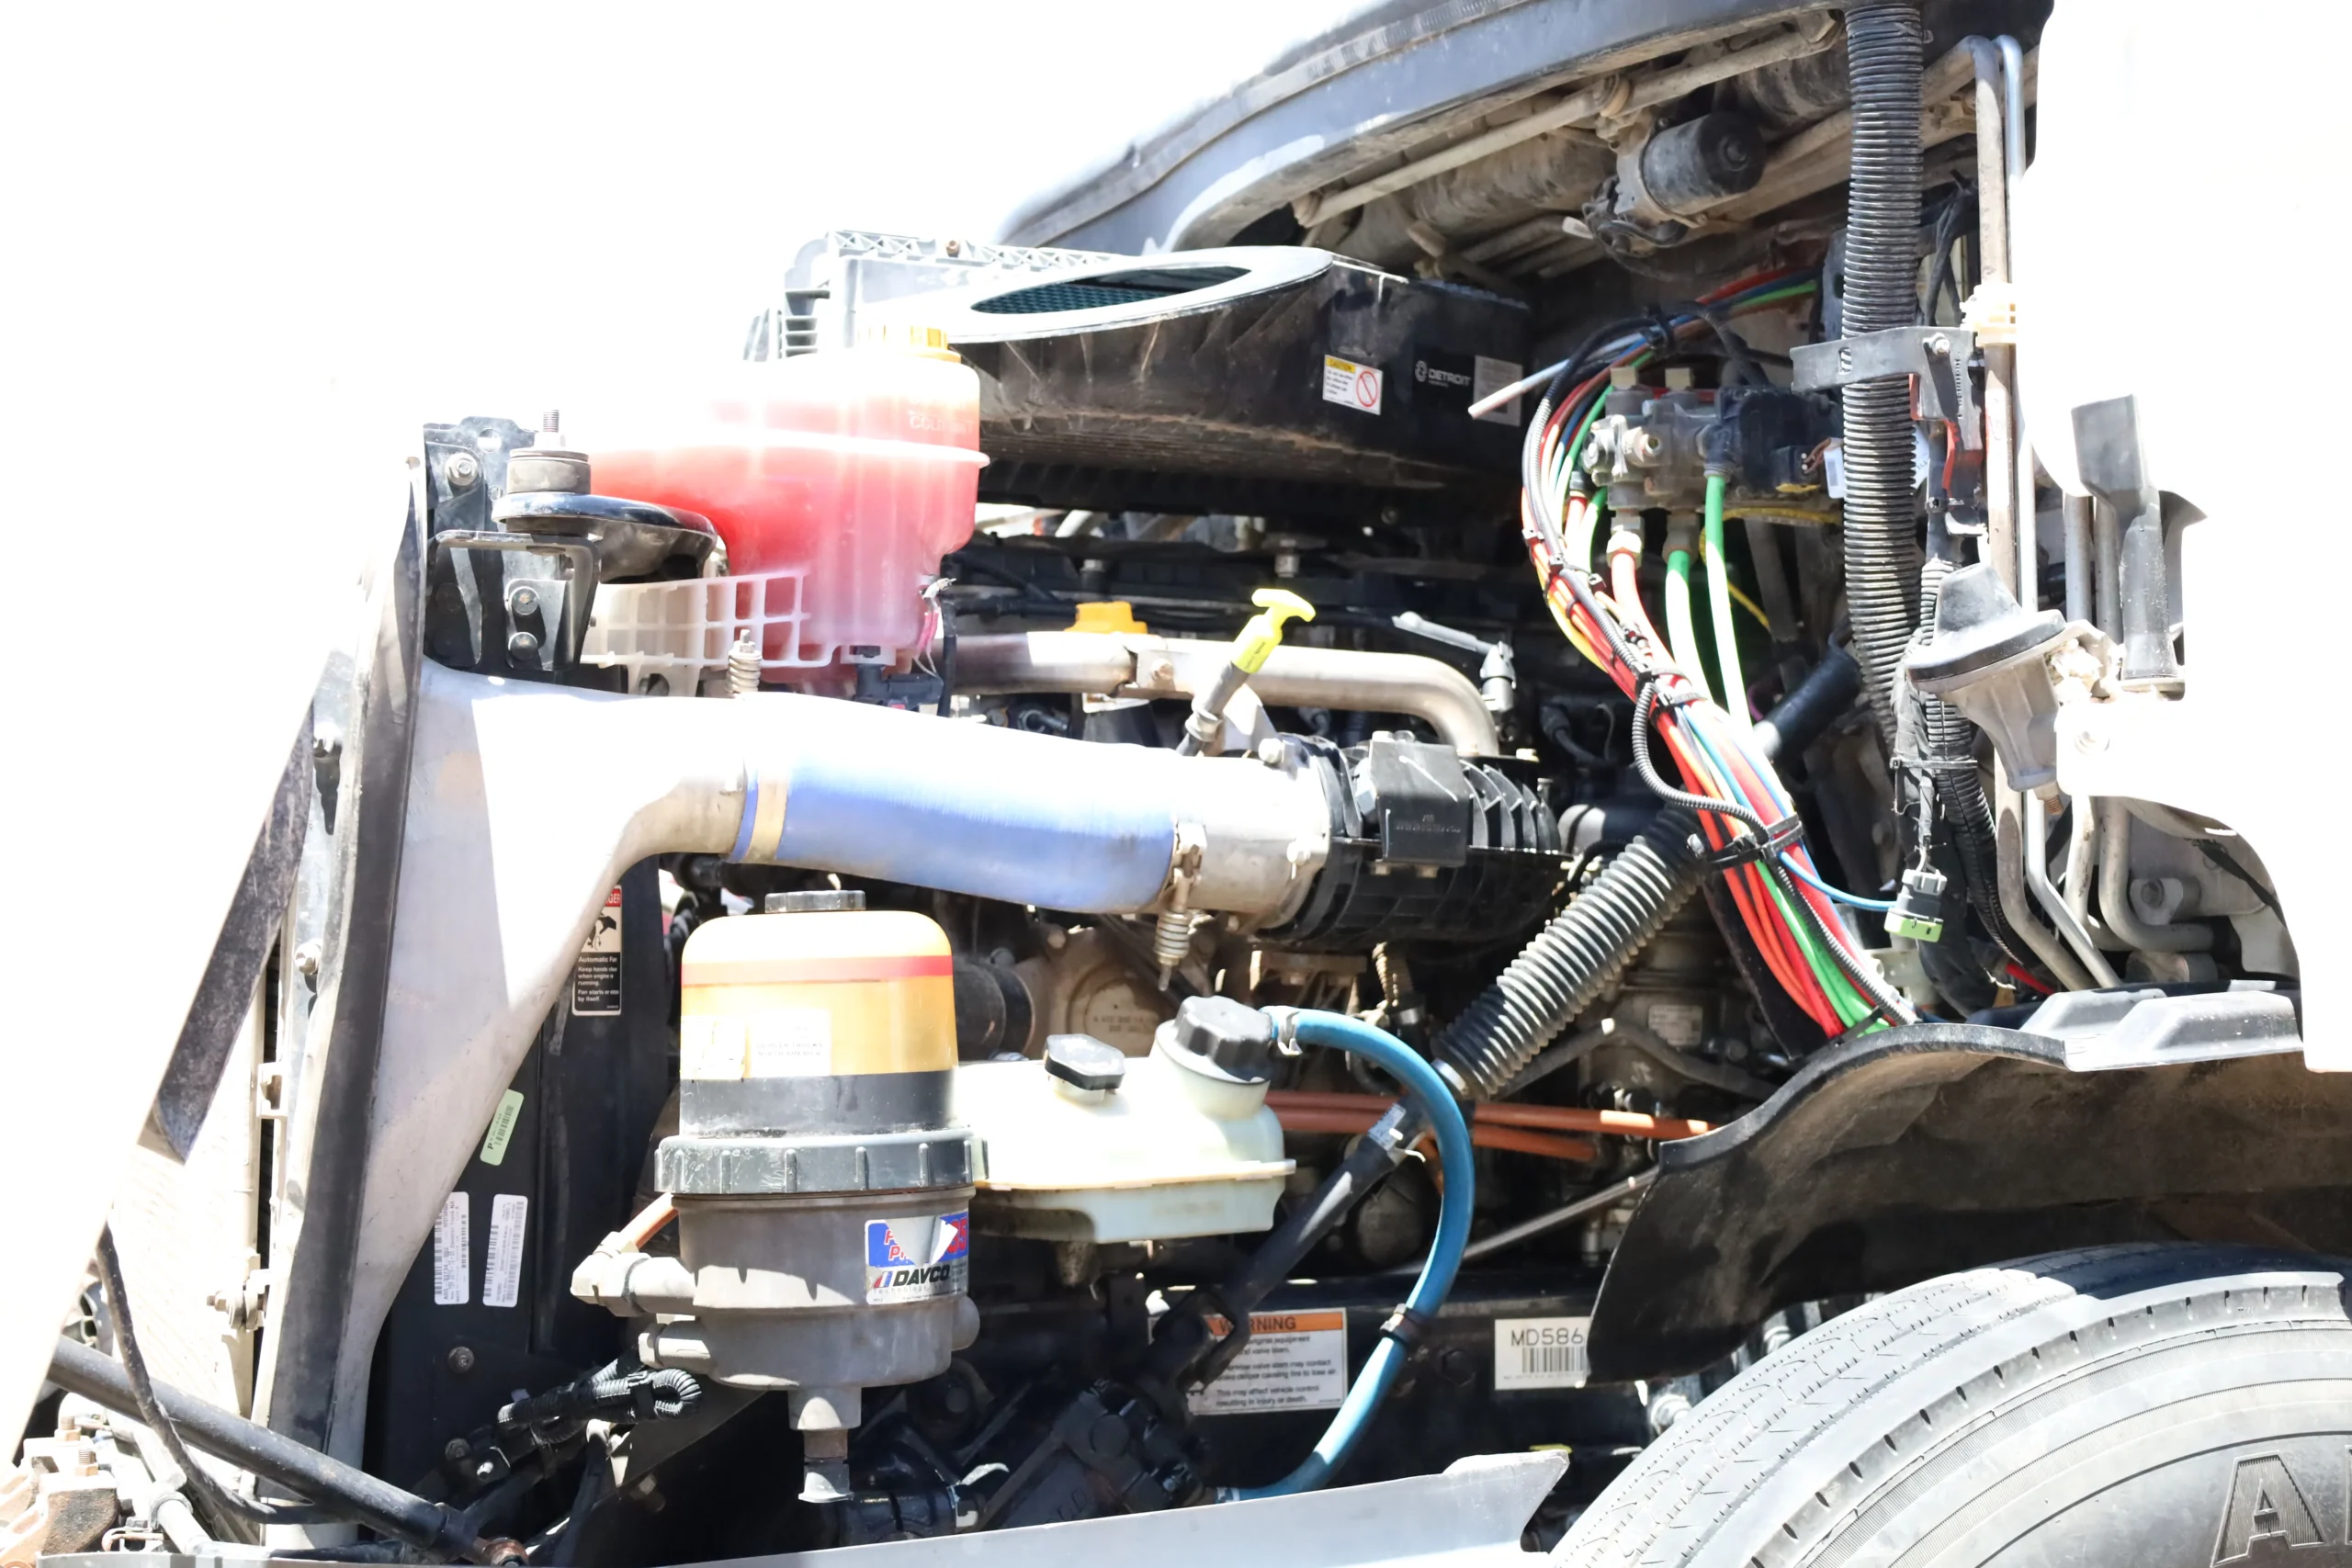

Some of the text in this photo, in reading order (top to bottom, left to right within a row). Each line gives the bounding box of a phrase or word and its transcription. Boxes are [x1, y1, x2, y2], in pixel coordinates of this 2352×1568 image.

[1428, 368, 1472, 386] DETROIT
[607, 893, 621, 904] GER
[893, 1264, 951, 1287] DAVCO
[1219, 1316, 1296, 1332] WRNING
[1510, 1327, 1584, 1347] MD586
[2210, 1445, 2352, 1568] A
